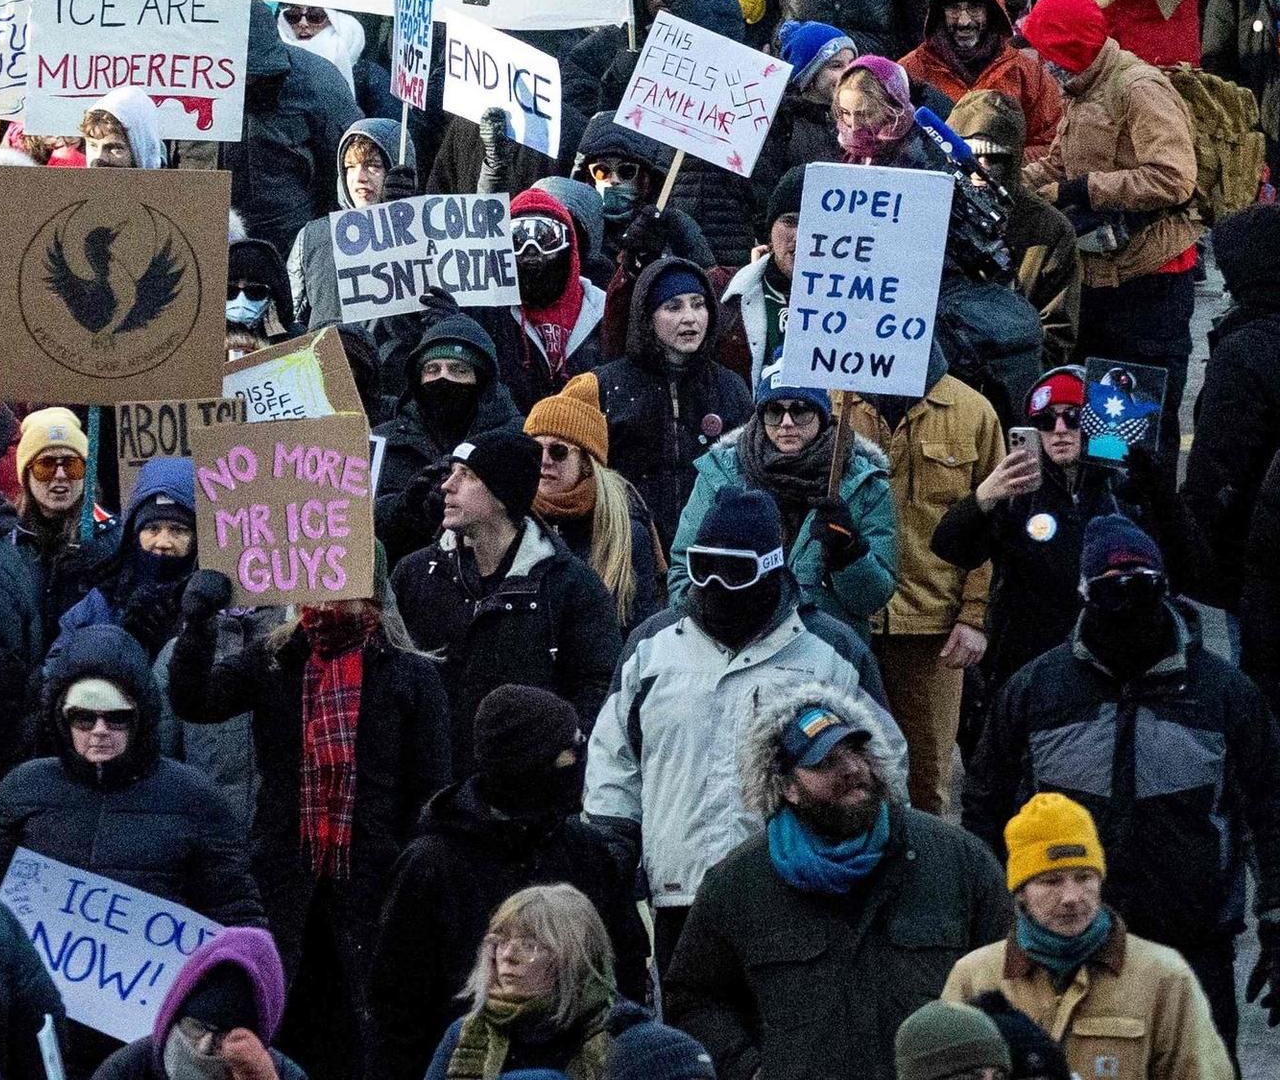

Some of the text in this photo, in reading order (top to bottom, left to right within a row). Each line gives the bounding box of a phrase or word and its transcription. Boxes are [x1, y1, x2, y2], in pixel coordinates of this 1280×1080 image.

[654, 21, 696, 51] THIS
[37, 54, 237, 90] MURDERERS
[447, 39, 553, 121] END ICE
[642, 46, 719, 92] FEELS
[629, 76, 737, 136] FAMILIAR
[335, 196, 508, 257] OUR COLOR
[820, 188, 903, 224] OPE!
[436, 247, 518, 295] CRIME
[809, 234, 875, 263] ICE
[801, 270, 899, 304] TIME
[796, 306, 927, 341] TO GO
[810, 346, 896, 379] NOW
[254, 393, 292, 416] OFF
[197, 441, 370, 503] NO MORE
[214, 497, 351, 549] MR ICE
[237, 544, 347, 595] GUYS
[58, 877, 133, 936] ICE
[31, 922, 166, 1007] NOW!
